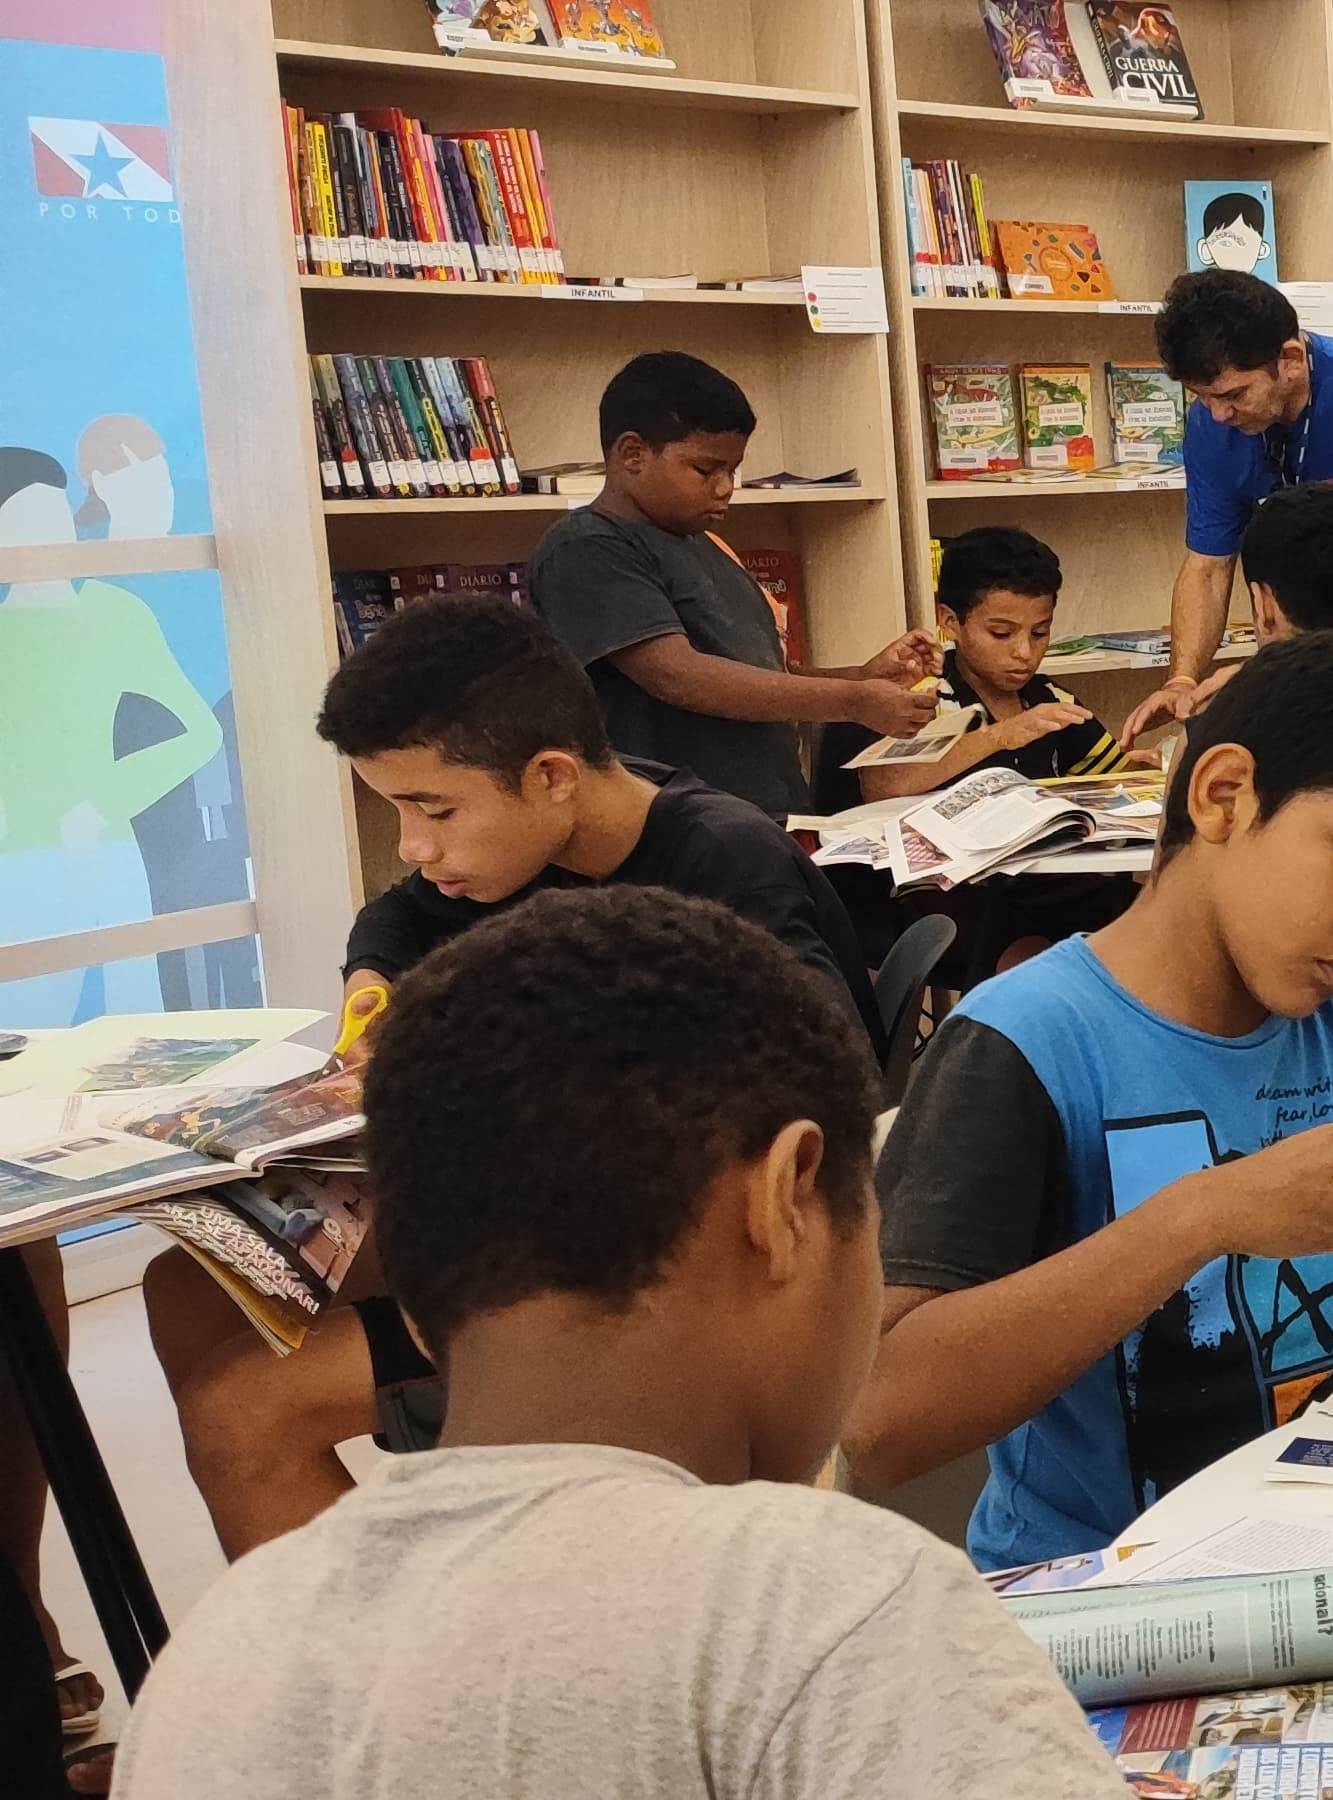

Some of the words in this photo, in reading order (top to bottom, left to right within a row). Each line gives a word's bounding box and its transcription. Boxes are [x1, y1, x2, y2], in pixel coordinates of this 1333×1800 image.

[1115, 56, 1179, 73] GUERRA
[1121, 73, 1197, 97] CIVIL
[39, 202, 98, 219] POR
[571, 288, 616, 299] INFANTIL
[200, 1206, 242, 1239] UMA
[247, 1234, 286, 1272] SALA
